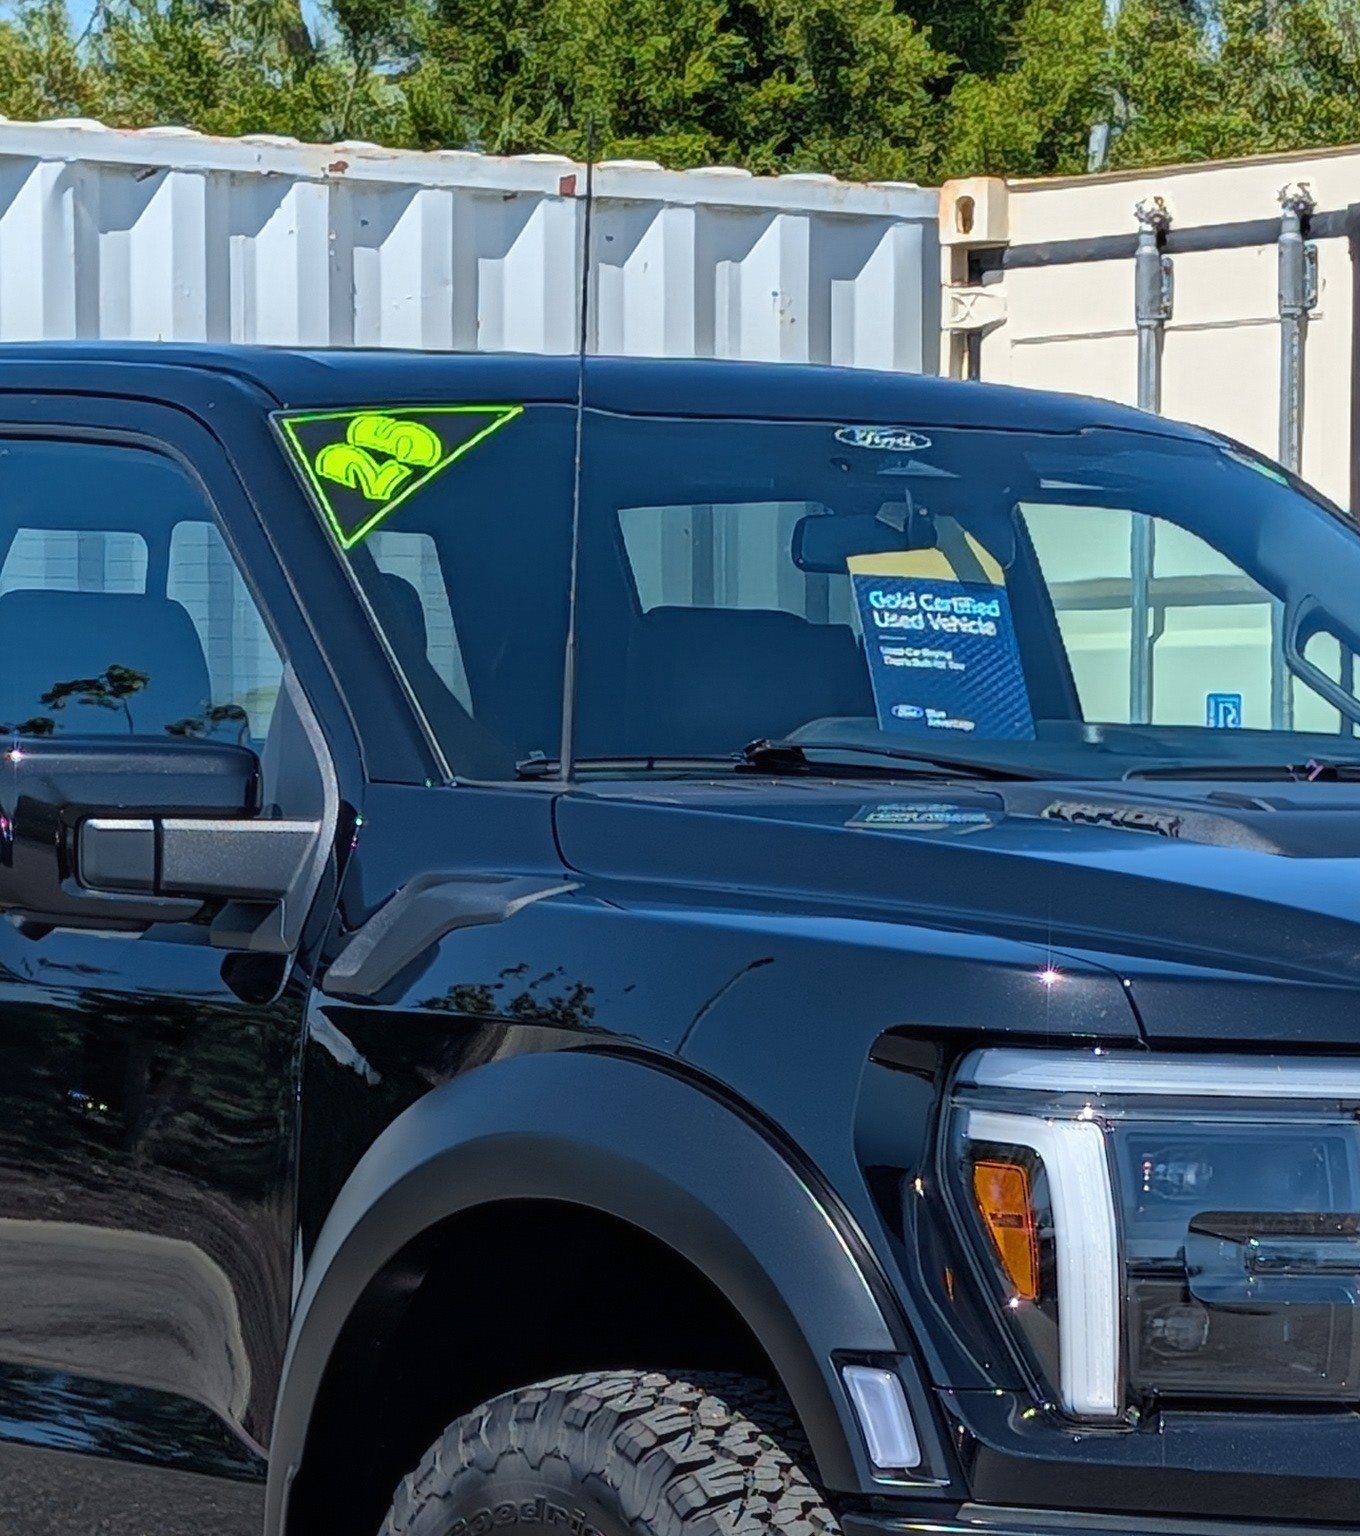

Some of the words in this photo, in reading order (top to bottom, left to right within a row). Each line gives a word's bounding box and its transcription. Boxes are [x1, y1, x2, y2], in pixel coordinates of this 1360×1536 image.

[315, 415, 442, 500] 25
[869, 590, 917, 609] Gold
[919, 593, 1001, 617] Certified
[872, 610, 925, 630] Used
[927, 612, 997, 636] Vehicle
